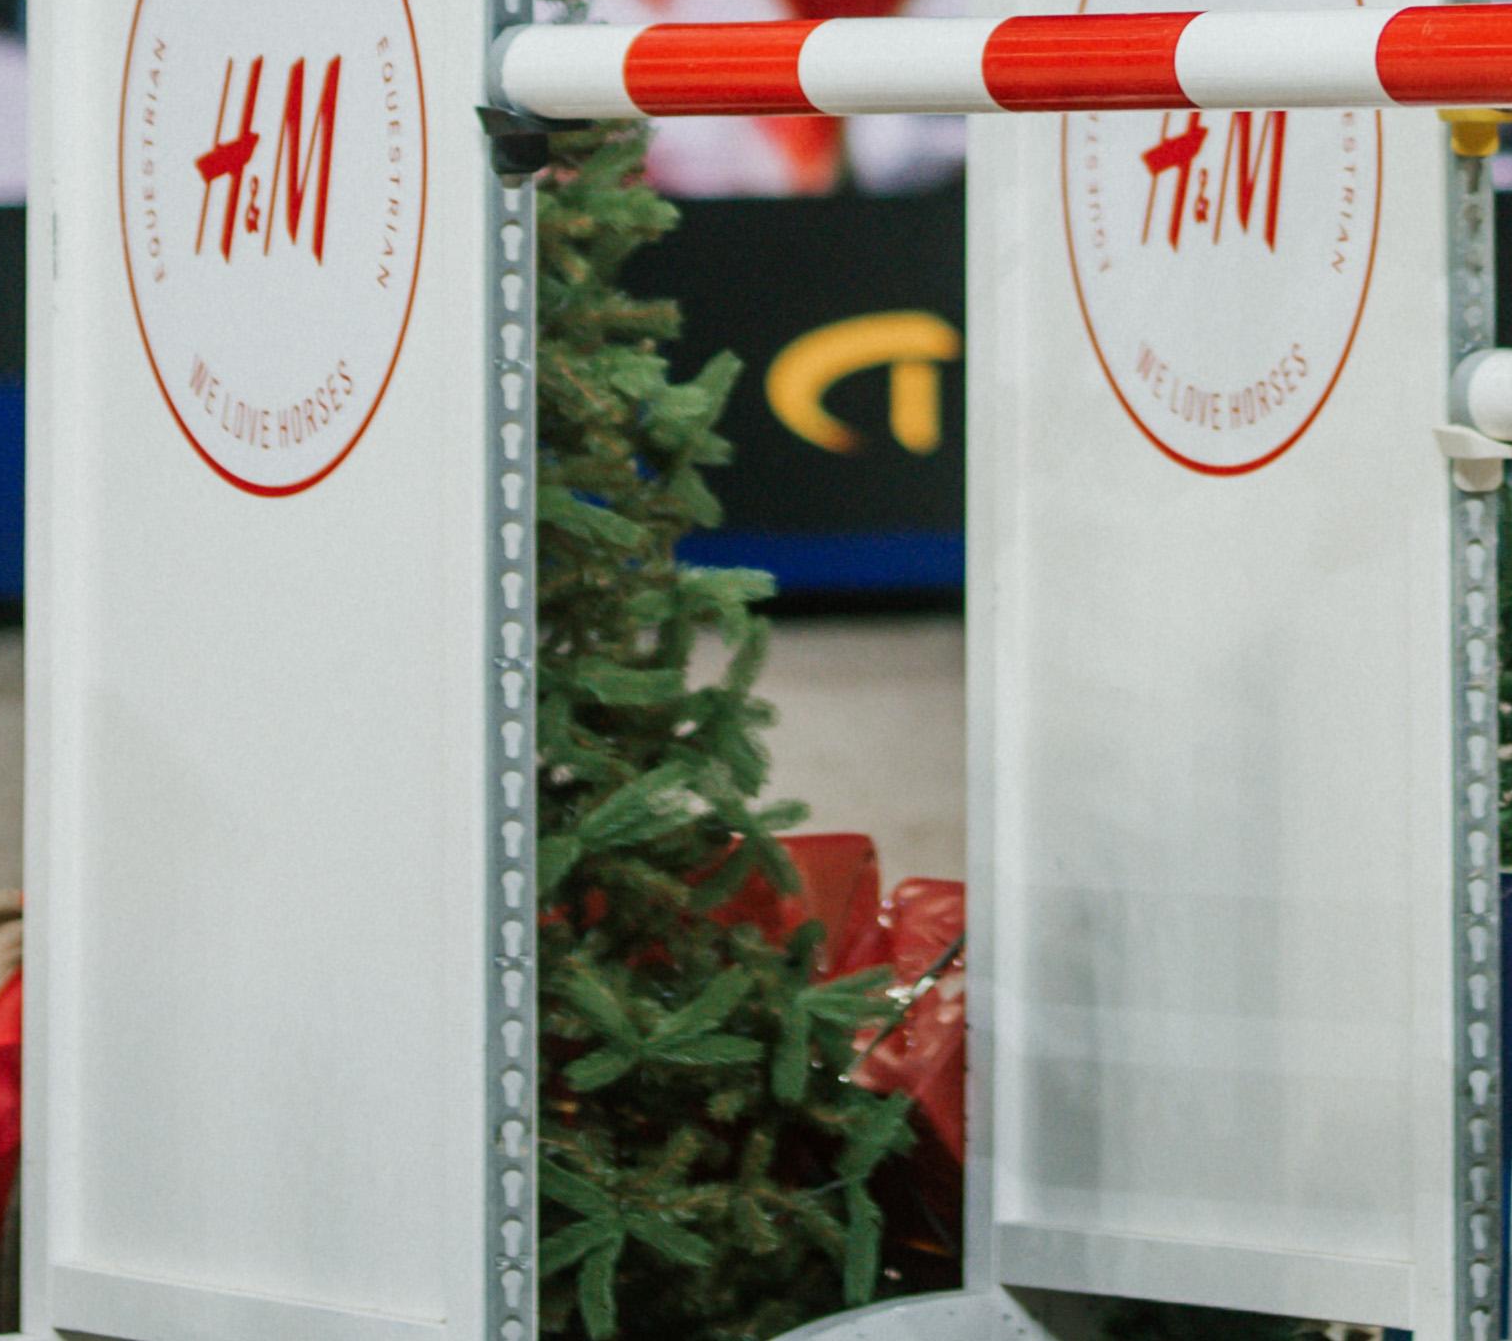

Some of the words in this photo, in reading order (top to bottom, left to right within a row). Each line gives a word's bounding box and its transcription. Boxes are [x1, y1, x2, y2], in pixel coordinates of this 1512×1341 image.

[141, 39, 167, 283] EQUESTRIAN
[195, 55, 342, 265] H&M
[376, 35, 402, 289] EQUESTRIAN
[190, 353, 220, 415] WE
[221, 392, 270, 450] LOVE
[277, 359, 354, 449] HORSES
[1171, 377, 1221, 431] LOVE
[1228, 342, 1308, 429] HORSES
